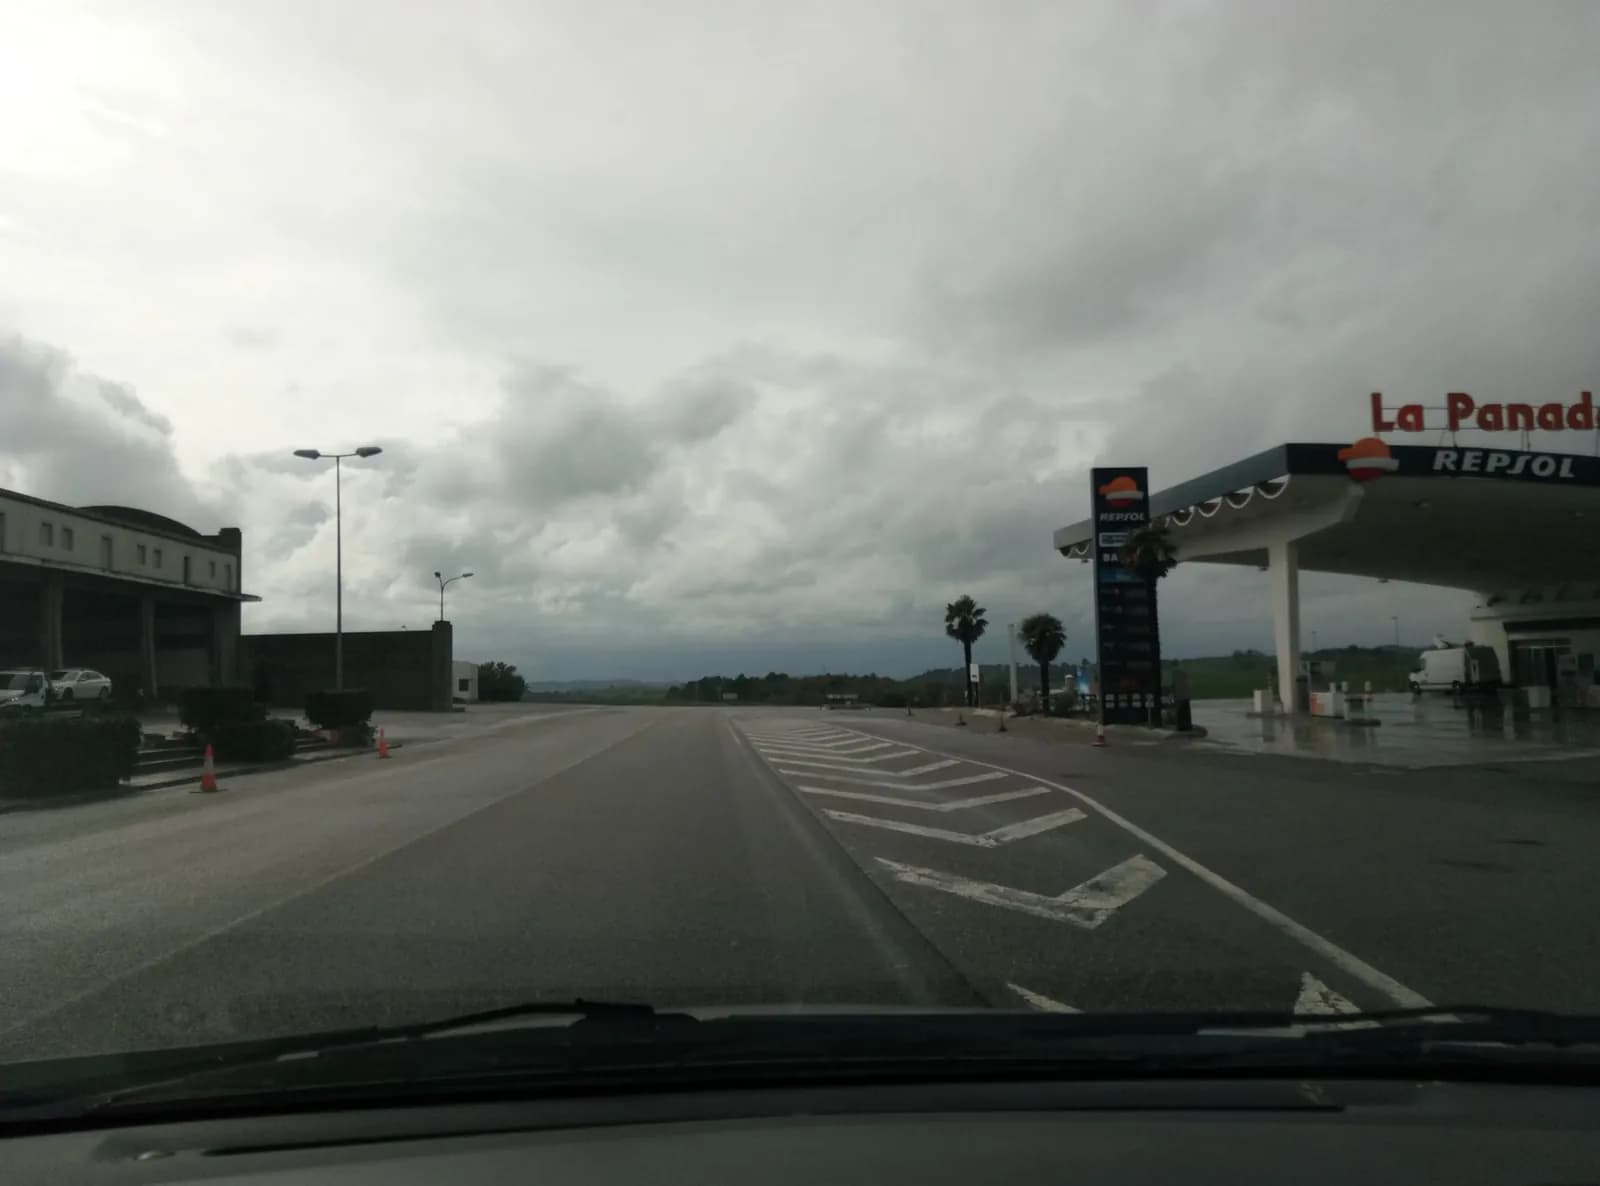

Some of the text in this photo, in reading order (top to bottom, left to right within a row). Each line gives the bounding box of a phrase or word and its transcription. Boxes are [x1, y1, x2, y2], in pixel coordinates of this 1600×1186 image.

[1371, 391, 1600, 432] La Panad
[1432, 449, 1576, 478] REPSOL
[1099, 512, 1145, 521] REPSOL
